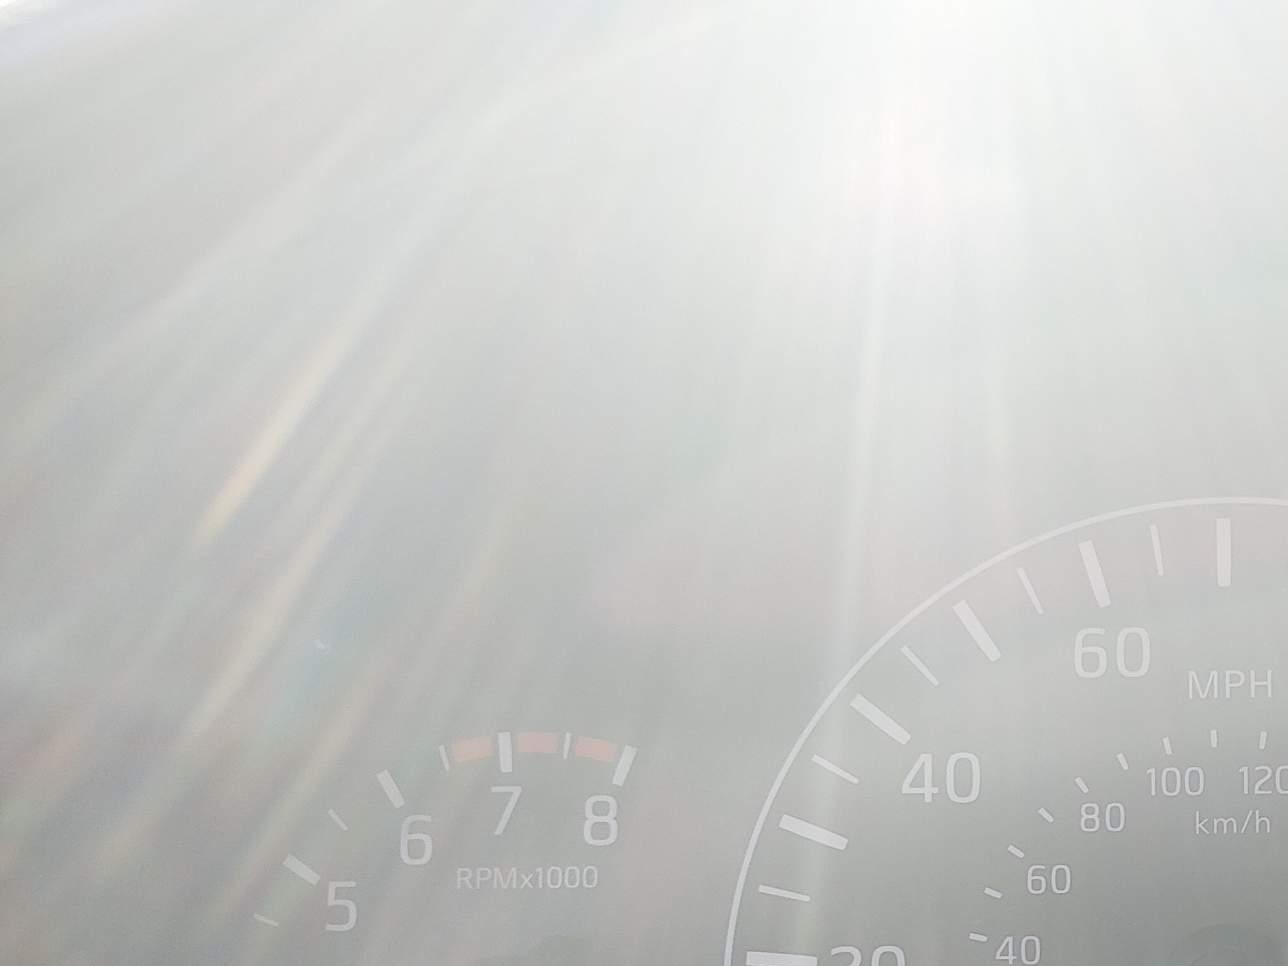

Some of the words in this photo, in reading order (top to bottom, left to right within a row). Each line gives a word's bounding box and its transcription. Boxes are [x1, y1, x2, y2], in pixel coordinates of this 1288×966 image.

[1073, 627, 1151, 679] 60
[1188, 670, 1273, 700] MPH
[900, 752, 981, 804] 40
[1146, 768, 1205, 796] 100
[490, 787, 522, 835] 7
[583, 795, 618, 846] 8
[1079, 803, 1125, 833] 80
[1194, 811, 1272, 836] km/h
[400, 814, 433, 865] 6
[456, 867, 598, 889] RPMx1000
[1025, 866, 1072, 895] 60
[325, 881, 357, 932] 5
[995, 937, 1042, 966] 40
